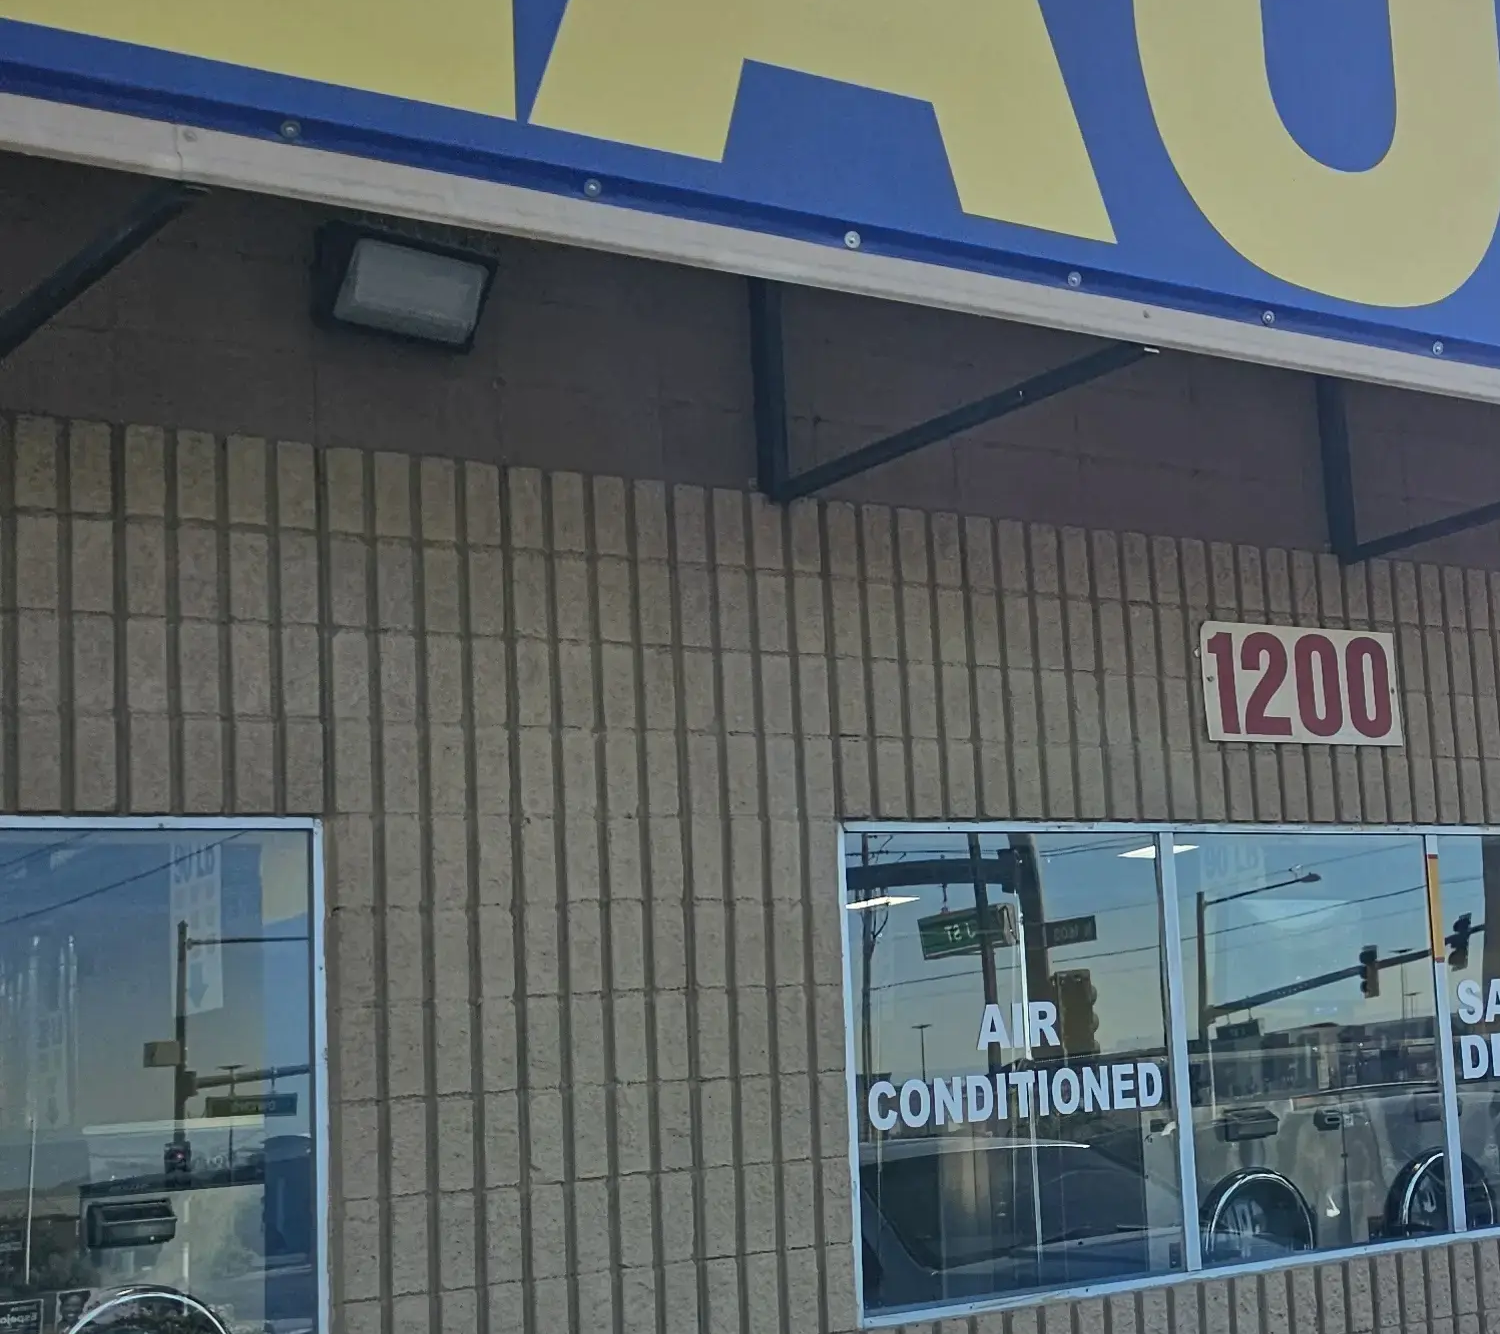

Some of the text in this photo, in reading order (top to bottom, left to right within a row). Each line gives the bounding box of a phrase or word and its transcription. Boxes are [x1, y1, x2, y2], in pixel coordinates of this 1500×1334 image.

[1207, 632, 1393, 738] 1200
[976, 1001, 1061, 1051] AIR
[868, 1062, 1163, 1130] CONDITIONED
